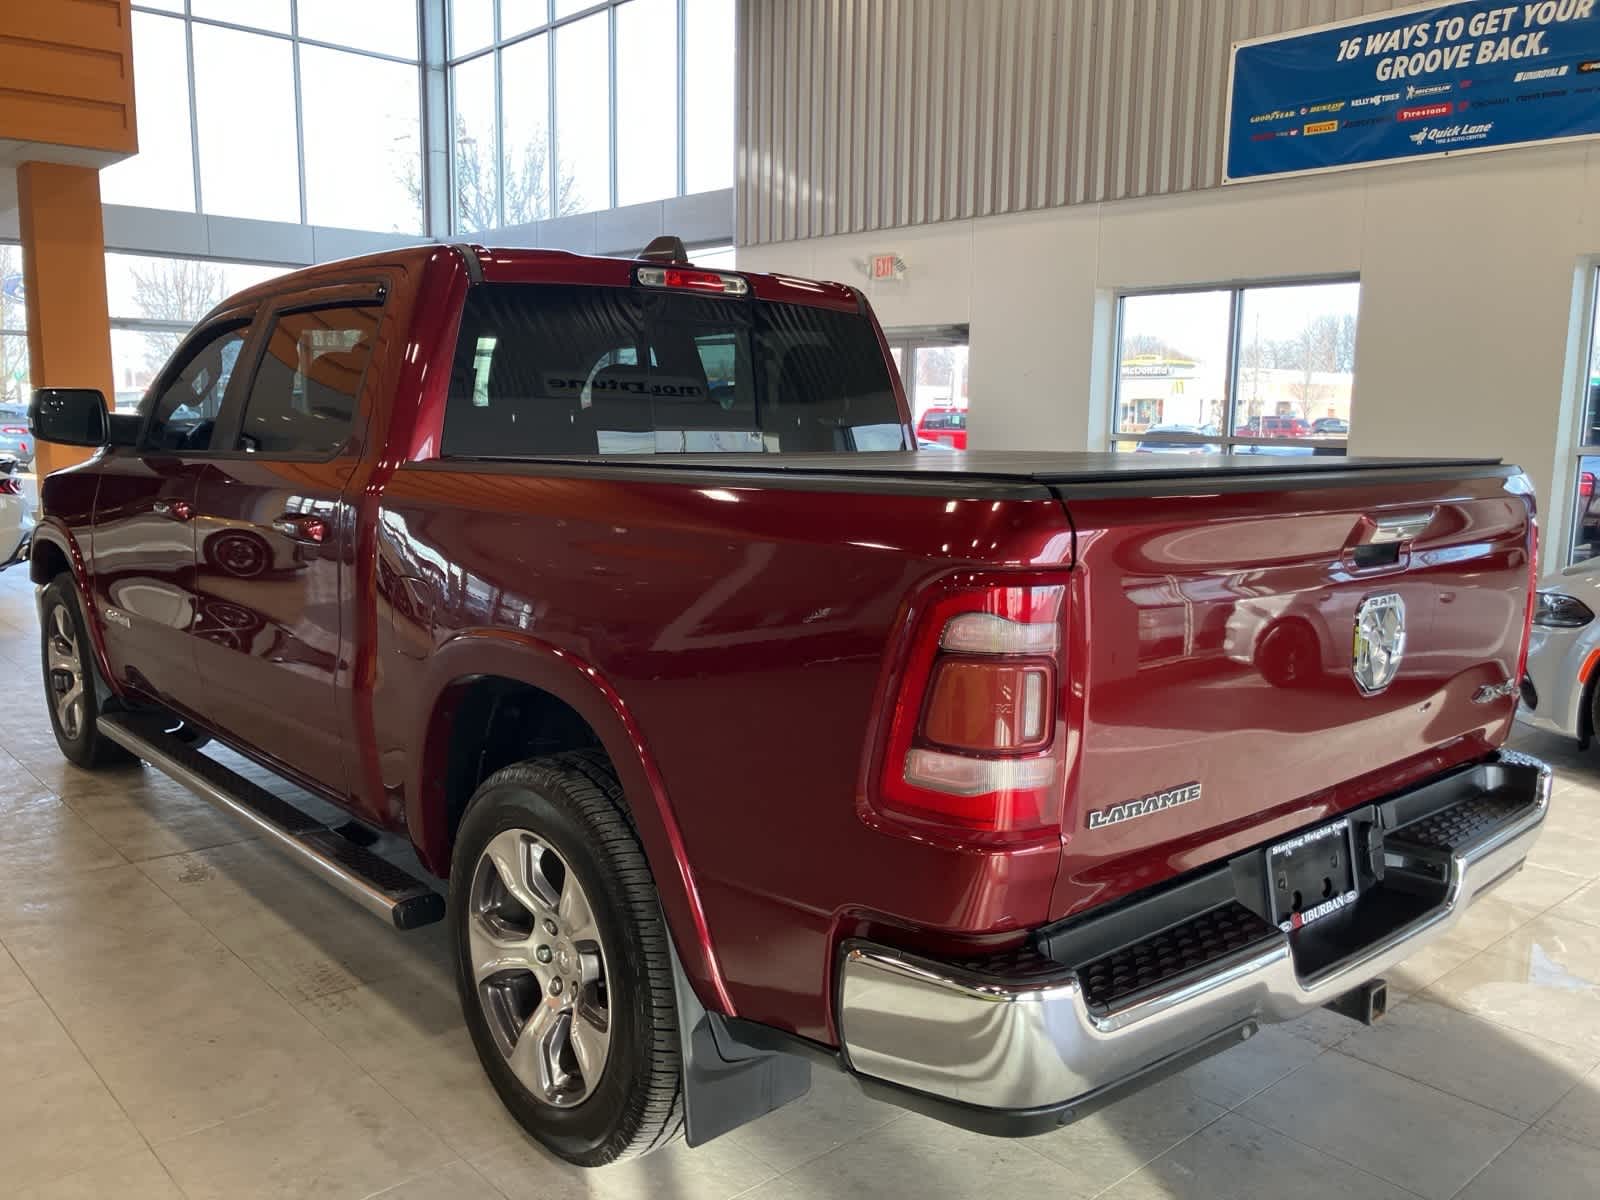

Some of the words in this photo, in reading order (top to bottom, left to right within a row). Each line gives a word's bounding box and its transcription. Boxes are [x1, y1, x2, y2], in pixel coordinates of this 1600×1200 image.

[1336, 37, 1362, 62] 16
[1364, 23, 1430, 56] WAYS
[1434, 17, 1465, 44] TO
[1468, 6, 1518, 37] GET
[1522, 0, 1595, 28] YOUR
[1375, 43, 1474, 82] GROOVE
[1475, 31, 1549, 65] BACK.
[1250, 110, 1296, 124] GOODYEAR
[1403, 107, 1447, 119] Firestone
[1428, 125, 1461, 141] Quick
[1461, 124, 1492, 135] Lane
[1370, 595, 1397, 606] RAM
[1089, 783, 1202, 830] LARAMIE
[1272, 838, 1304, 855] Sterling
[1304, 827, 1332, 842] Heights
